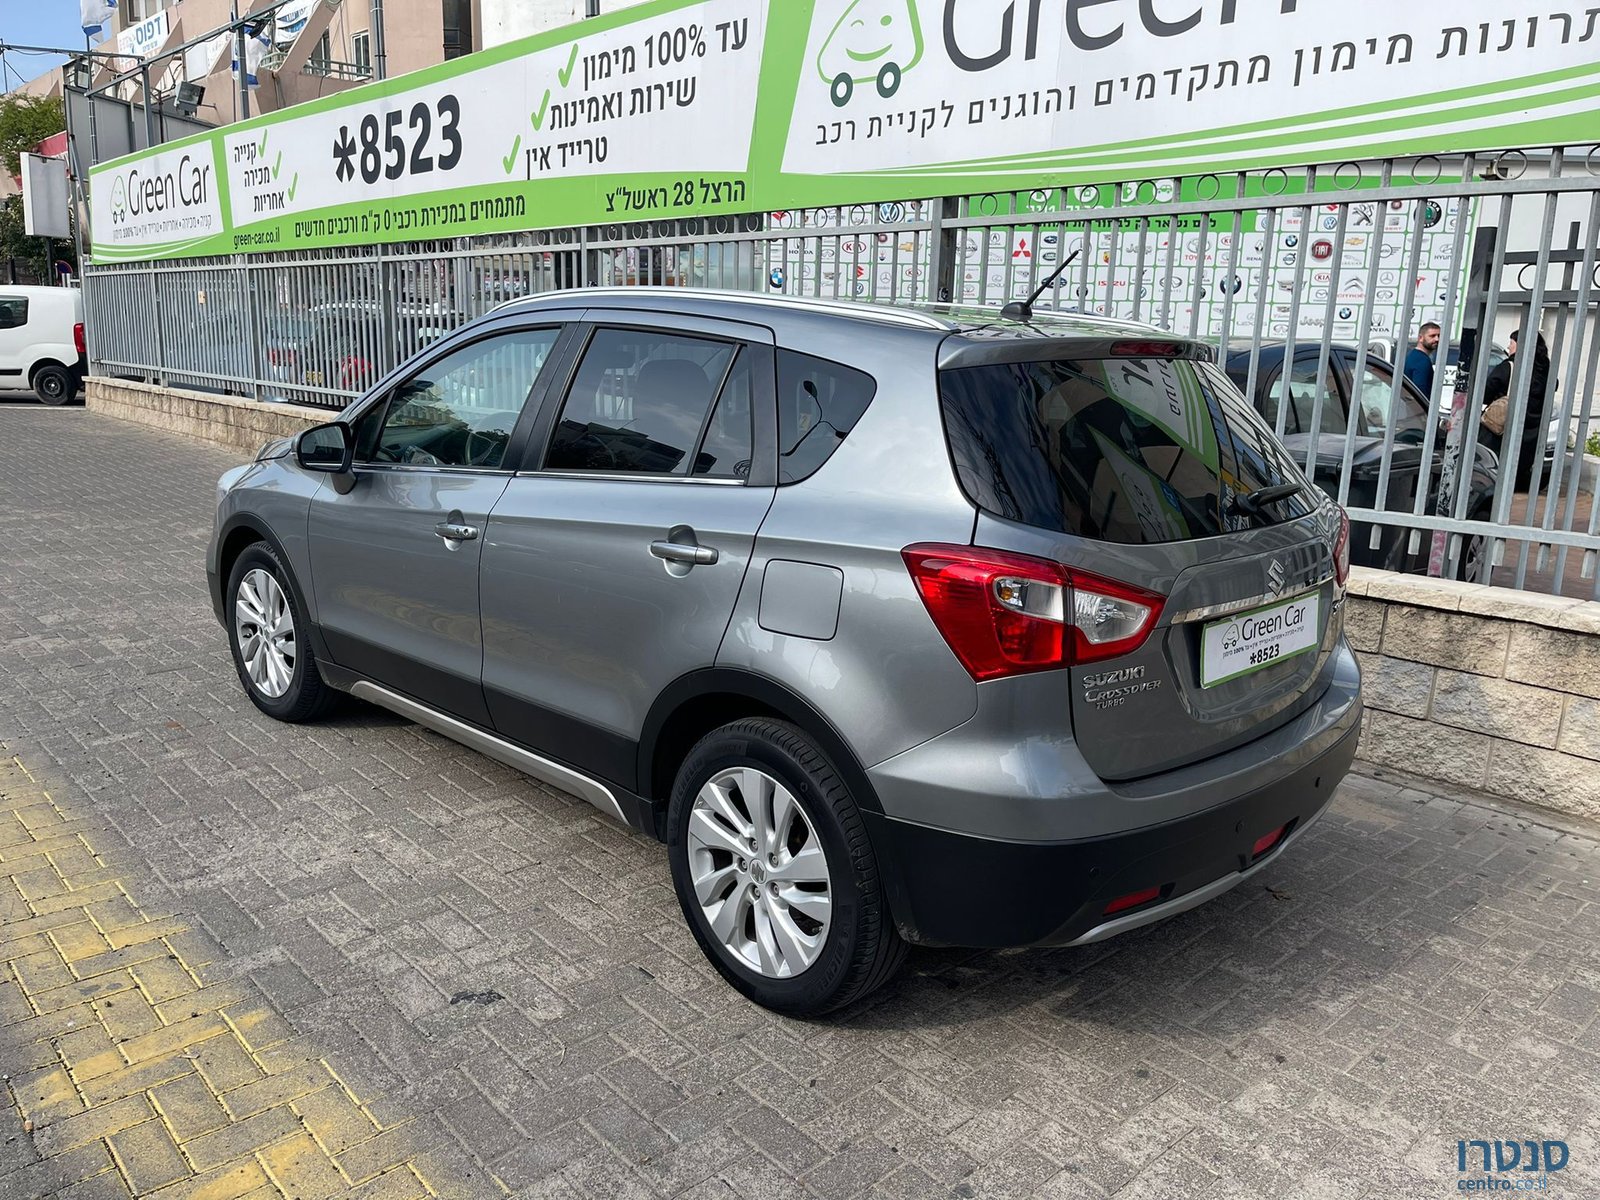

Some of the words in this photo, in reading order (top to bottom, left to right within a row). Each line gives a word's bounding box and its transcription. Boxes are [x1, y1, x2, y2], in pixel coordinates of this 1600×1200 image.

[136, 17, 160, 45] דפוס
[715, 18, 748, 52] עד
[943, 0, 1298, 71] Gre
[644, 24, 706, 68] 100%
[582, 45, 635, 91] מימון
[1293, 33, 1413, 86] מימון
[1094, 54, 1271, 107] מתקדמים
[629, 77, 696, 117] שירות
[968, 84, 1076, 124] והוגנים
[550, 90, 623, 131] ואמינות
[866, 100, 954, 138] לקניית
[815, 120, 856, 145] רכב
[234, 141, 257, 165] קנייה
[525, 145, 551, 180] אין
[557, 136, 608, 169] טרייד
[128, 169, 176, 216] Green
[178, 154, 210, 207] Car
[244, 166, 270, 188] מכירה
[253, 190, 285, 213] אחריות
[673, 182, 694, 207] 28
[700, 179, 746, 204] הרצל
[384, 209, 390, 230] 0
[393, 210, 417, 230] רכבי
[421, 203, 466, 227] במכירת
[470, 195, 525, 221] מתמחים
[295, 218, 325, 238] חדשים
[327, 215, 358, 235] ורכבים
[1193, 218, 1216, 228] לם
[233, 226, 281, 249] green-car.co.il
[1315, 246, 1329, 256] FIAT
[1242, 615, 1282, 641] Green
[1285, 605, 1306, 627] Car
[1083, 665, 1145, 688] SUZUKI
[1096, 697, 1125, 710] TURBO
